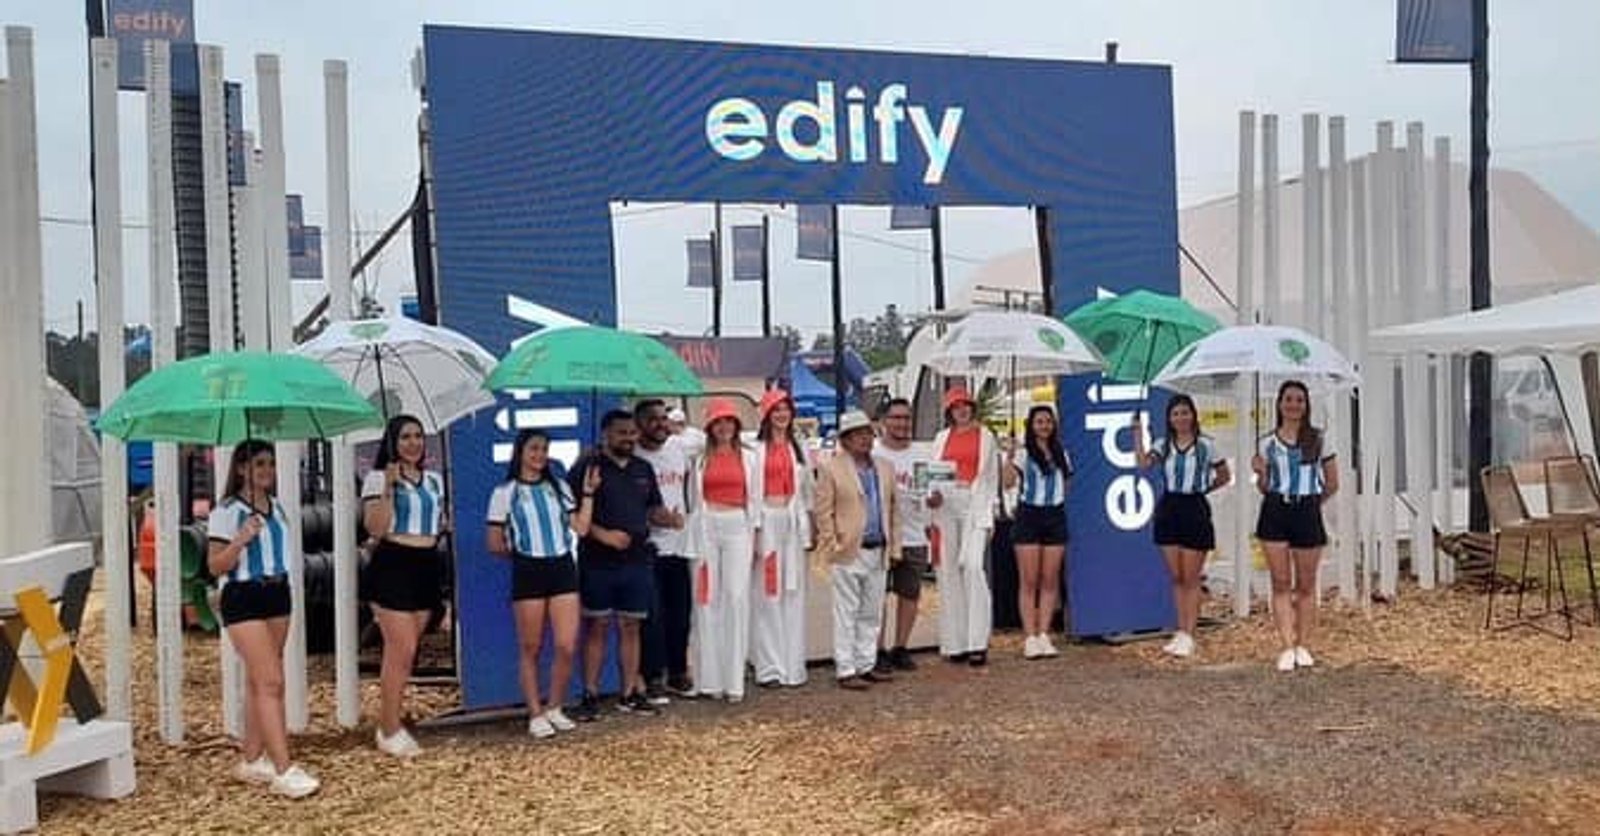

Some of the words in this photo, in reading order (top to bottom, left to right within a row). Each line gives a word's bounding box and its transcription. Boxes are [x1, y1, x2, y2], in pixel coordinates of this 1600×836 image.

[114, 9, 187, 38] edify
[705, 80, 964, 185] edify
[1085, 286, 1155, 532] edi
